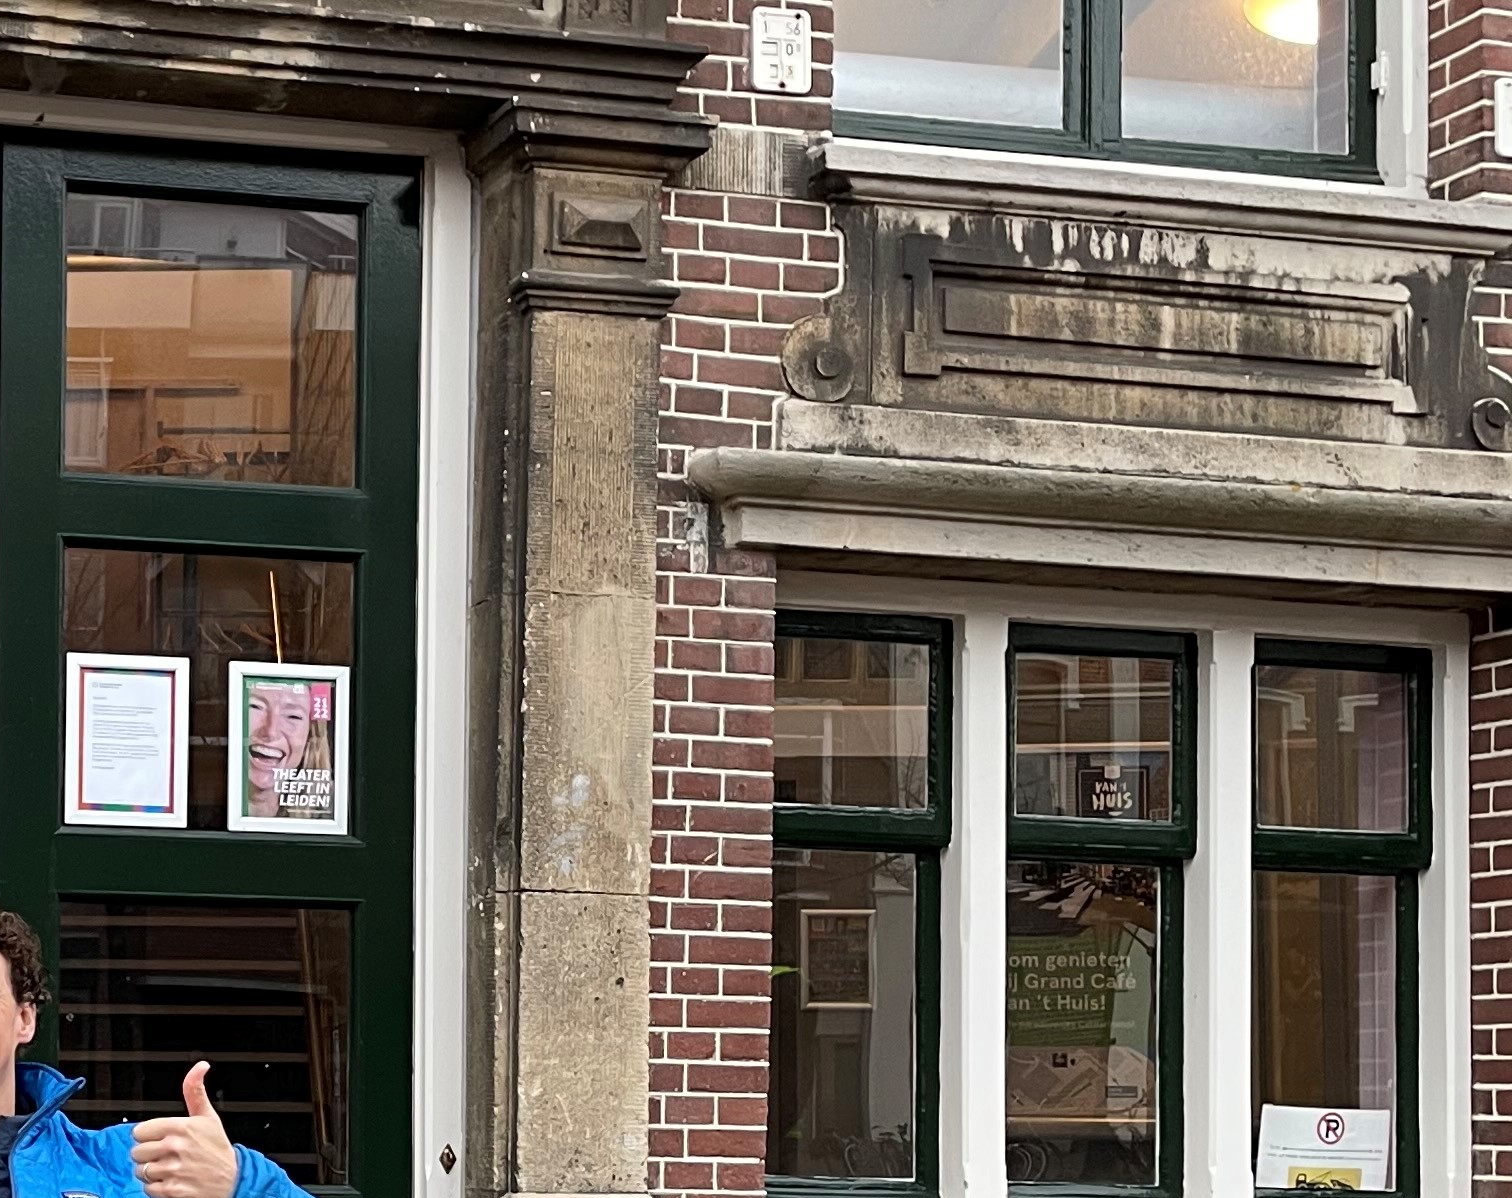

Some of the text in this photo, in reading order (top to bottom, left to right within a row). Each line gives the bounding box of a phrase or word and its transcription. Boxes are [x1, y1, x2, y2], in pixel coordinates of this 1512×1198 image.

[313, 697, 328, 708] 21
[313, 707, 329, 718] 22
[272, 767, 330, 781] THEATER
[274, 781, 330, 794] LEEFT IN
[279, 794, 330, 808] LEIDEN!
[1092, 791, 1133, 811] HUIS
[1009, 951, 1131, 972] om genieten
[1008, 972, 1137, 993] ij Grand Café
[1007, 998, 1030, 1011] an
[1057, 995, 1106, 1011] Huis!
